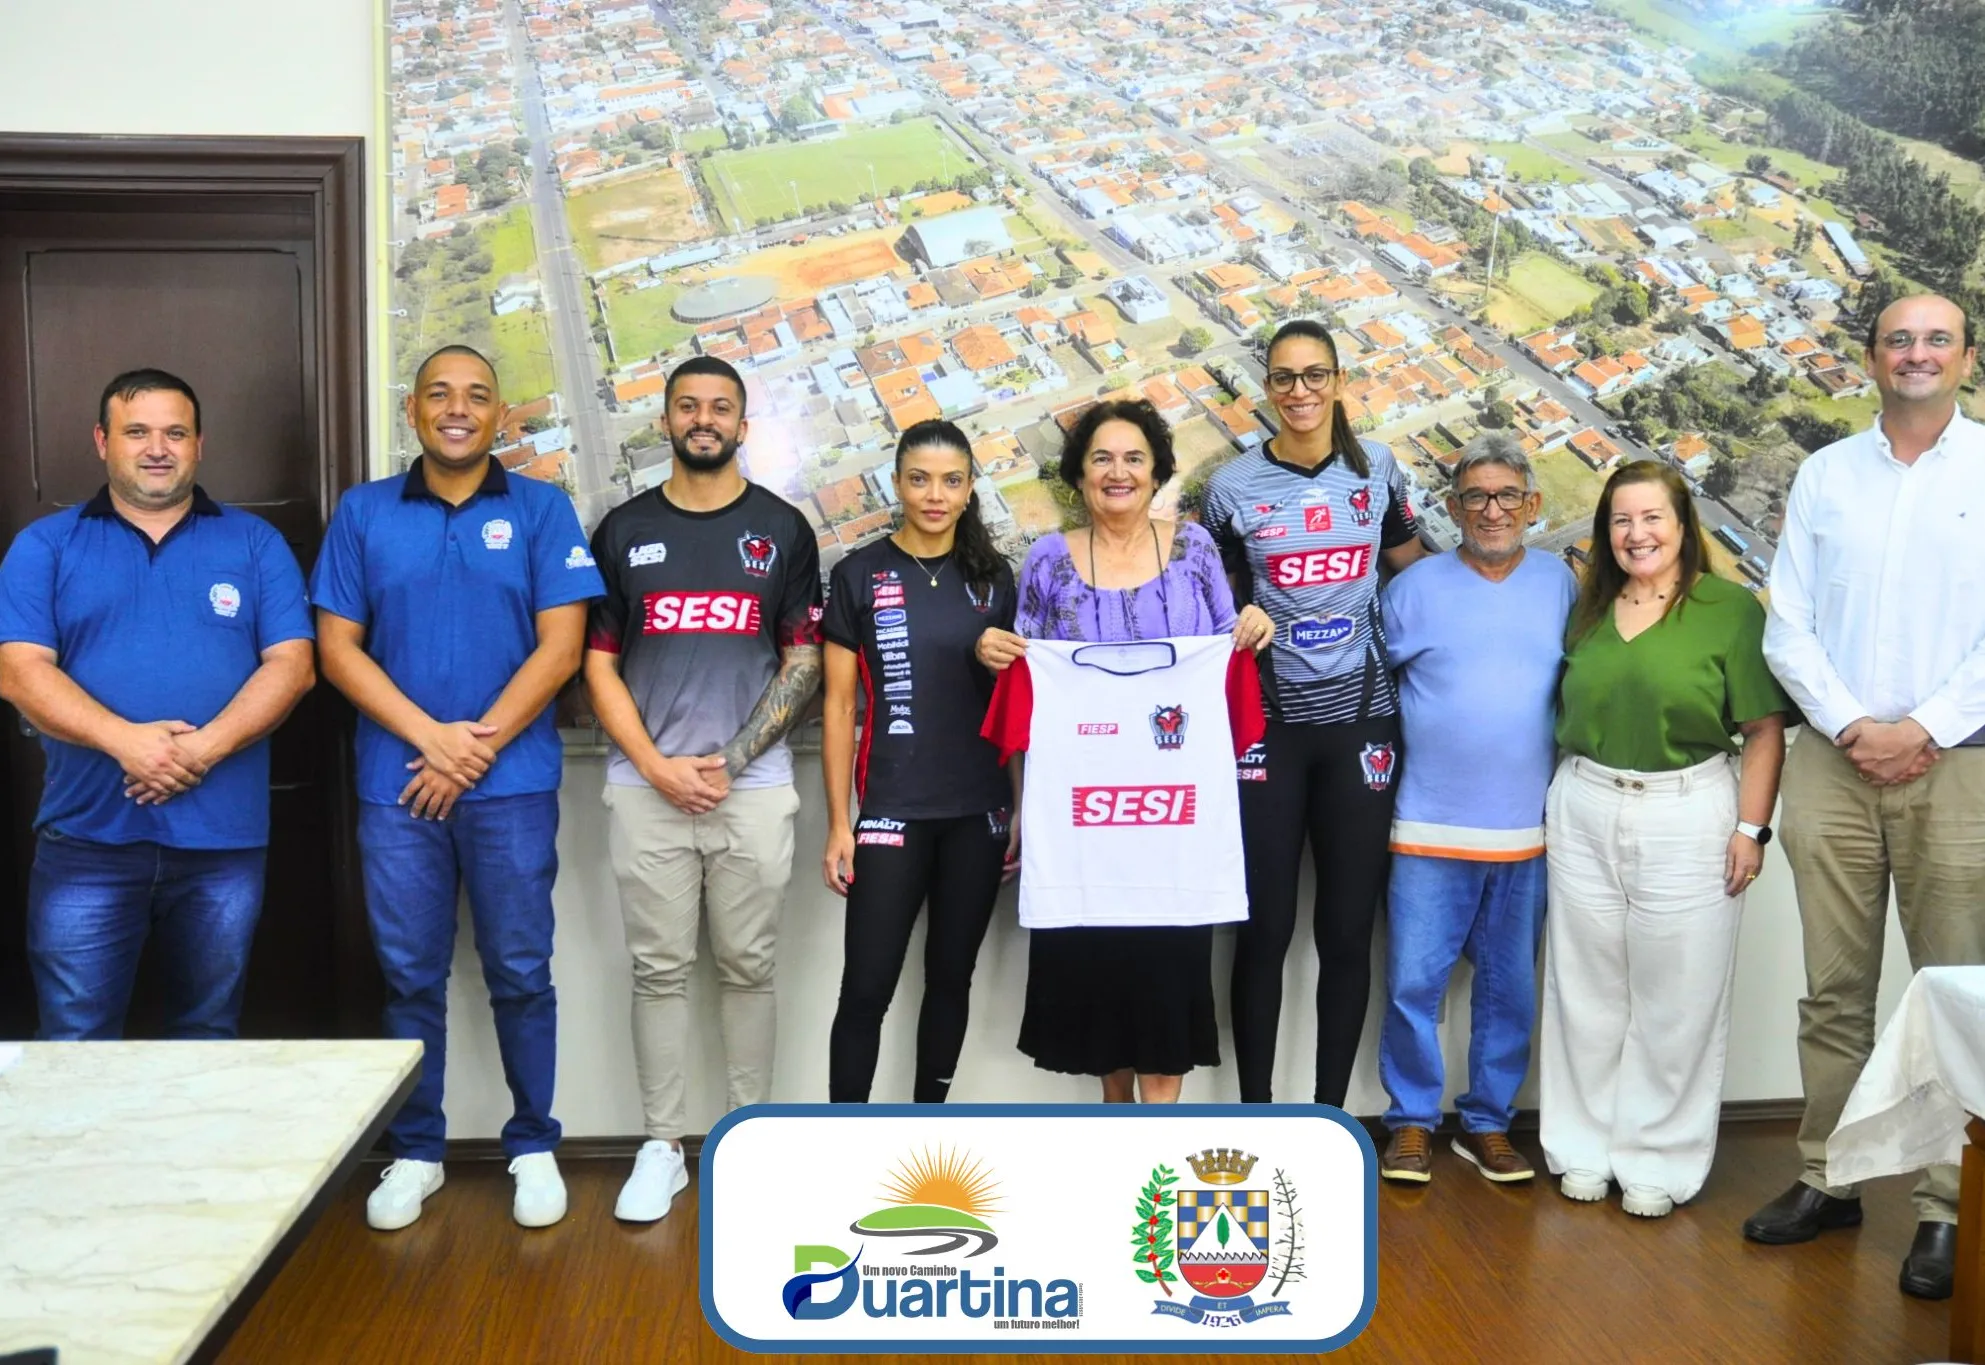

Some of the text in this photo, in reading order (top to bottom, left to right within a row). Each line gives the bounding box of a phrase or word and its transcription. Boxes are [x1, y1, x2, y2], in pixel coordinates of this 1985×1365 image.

[1278, 549, 1364, 586] SESI
[652, 596, 752, 630] SESI
[1296, 626, 1349, 642] MEZZA
[1080, 725, 1115, 735] FIESP
[1156, 736, 1183, 745] SESI
[1237, 769, 1263, 780] ESP
[1367, 774, 1390, 783] SESI
[1082, 790, 1185, 824] SESI
[858, 820, 906, 831] PENALTY
[858, 832, 899, 845] FIESP
